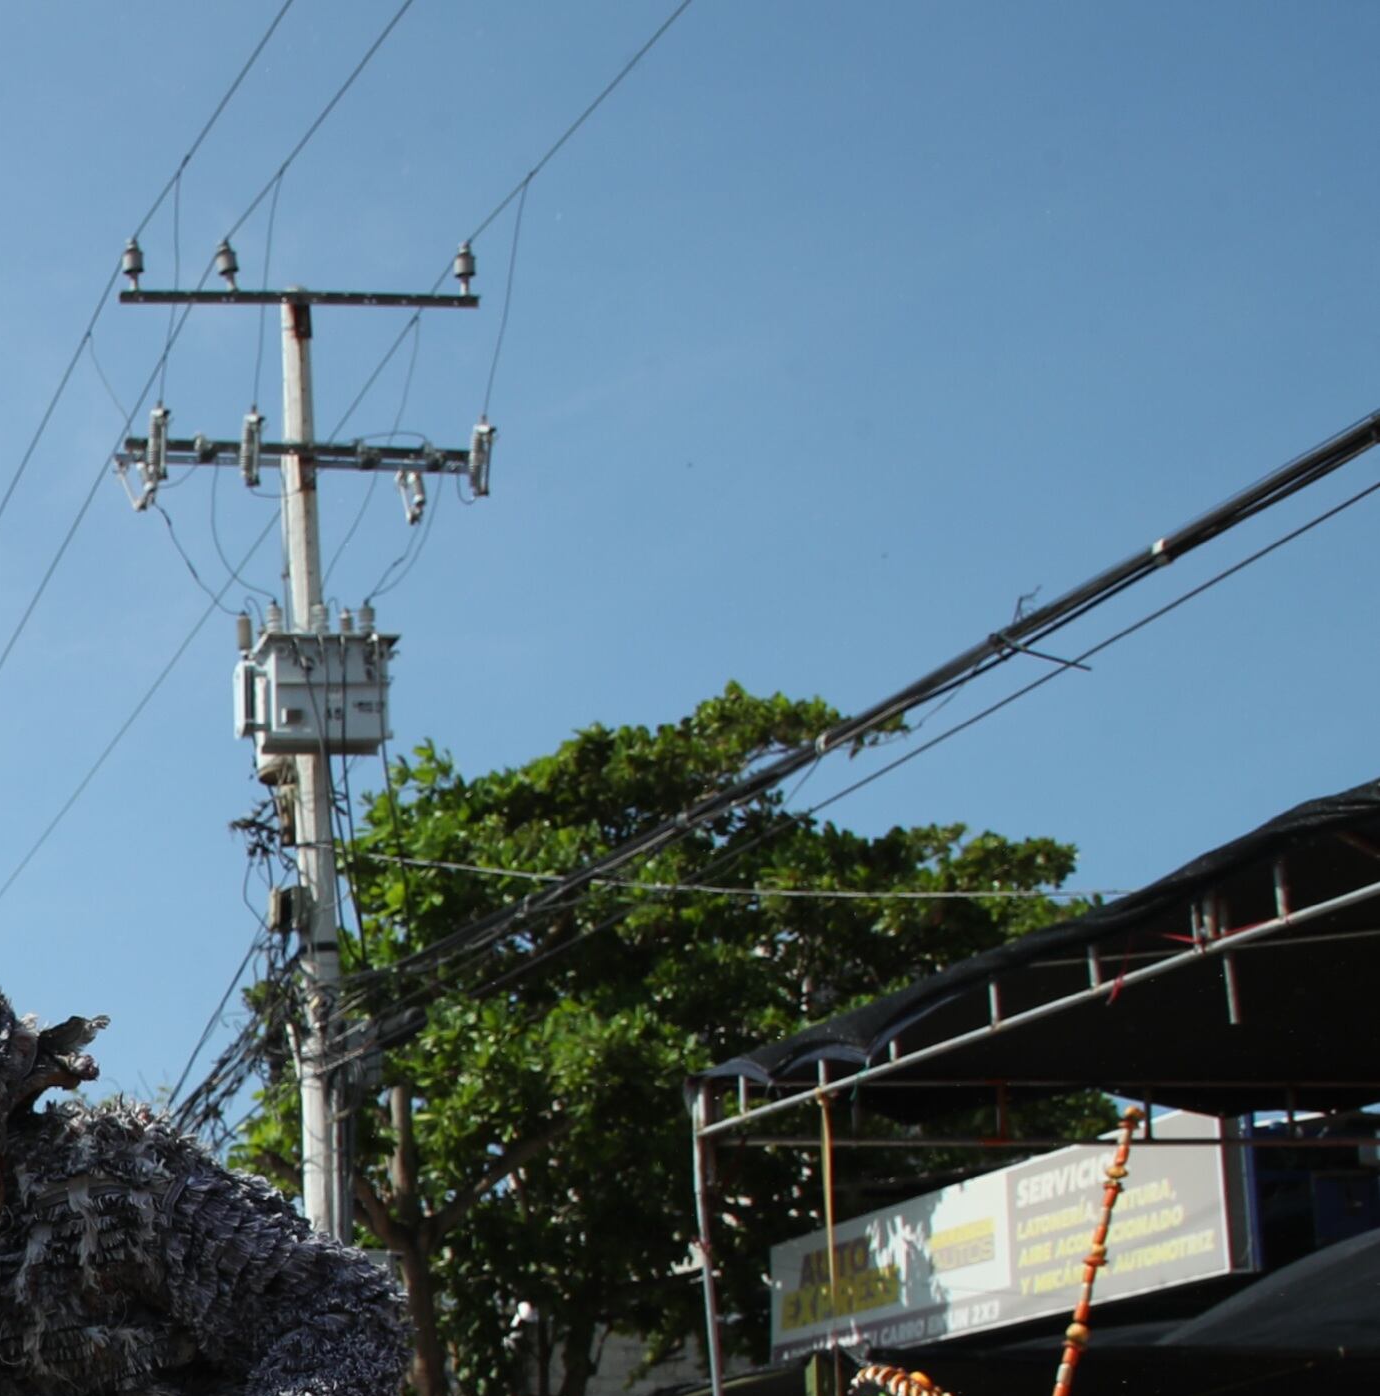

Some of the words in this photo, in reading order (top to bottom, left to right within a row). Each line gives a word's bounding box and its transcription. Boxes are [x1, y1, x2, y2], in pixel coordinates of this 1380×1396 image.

[1020, 1276, 1032, 1297] Y
[880, 1318, 925, 1347] CARRO
[971, 1300, 1000, 1323] 2X3
